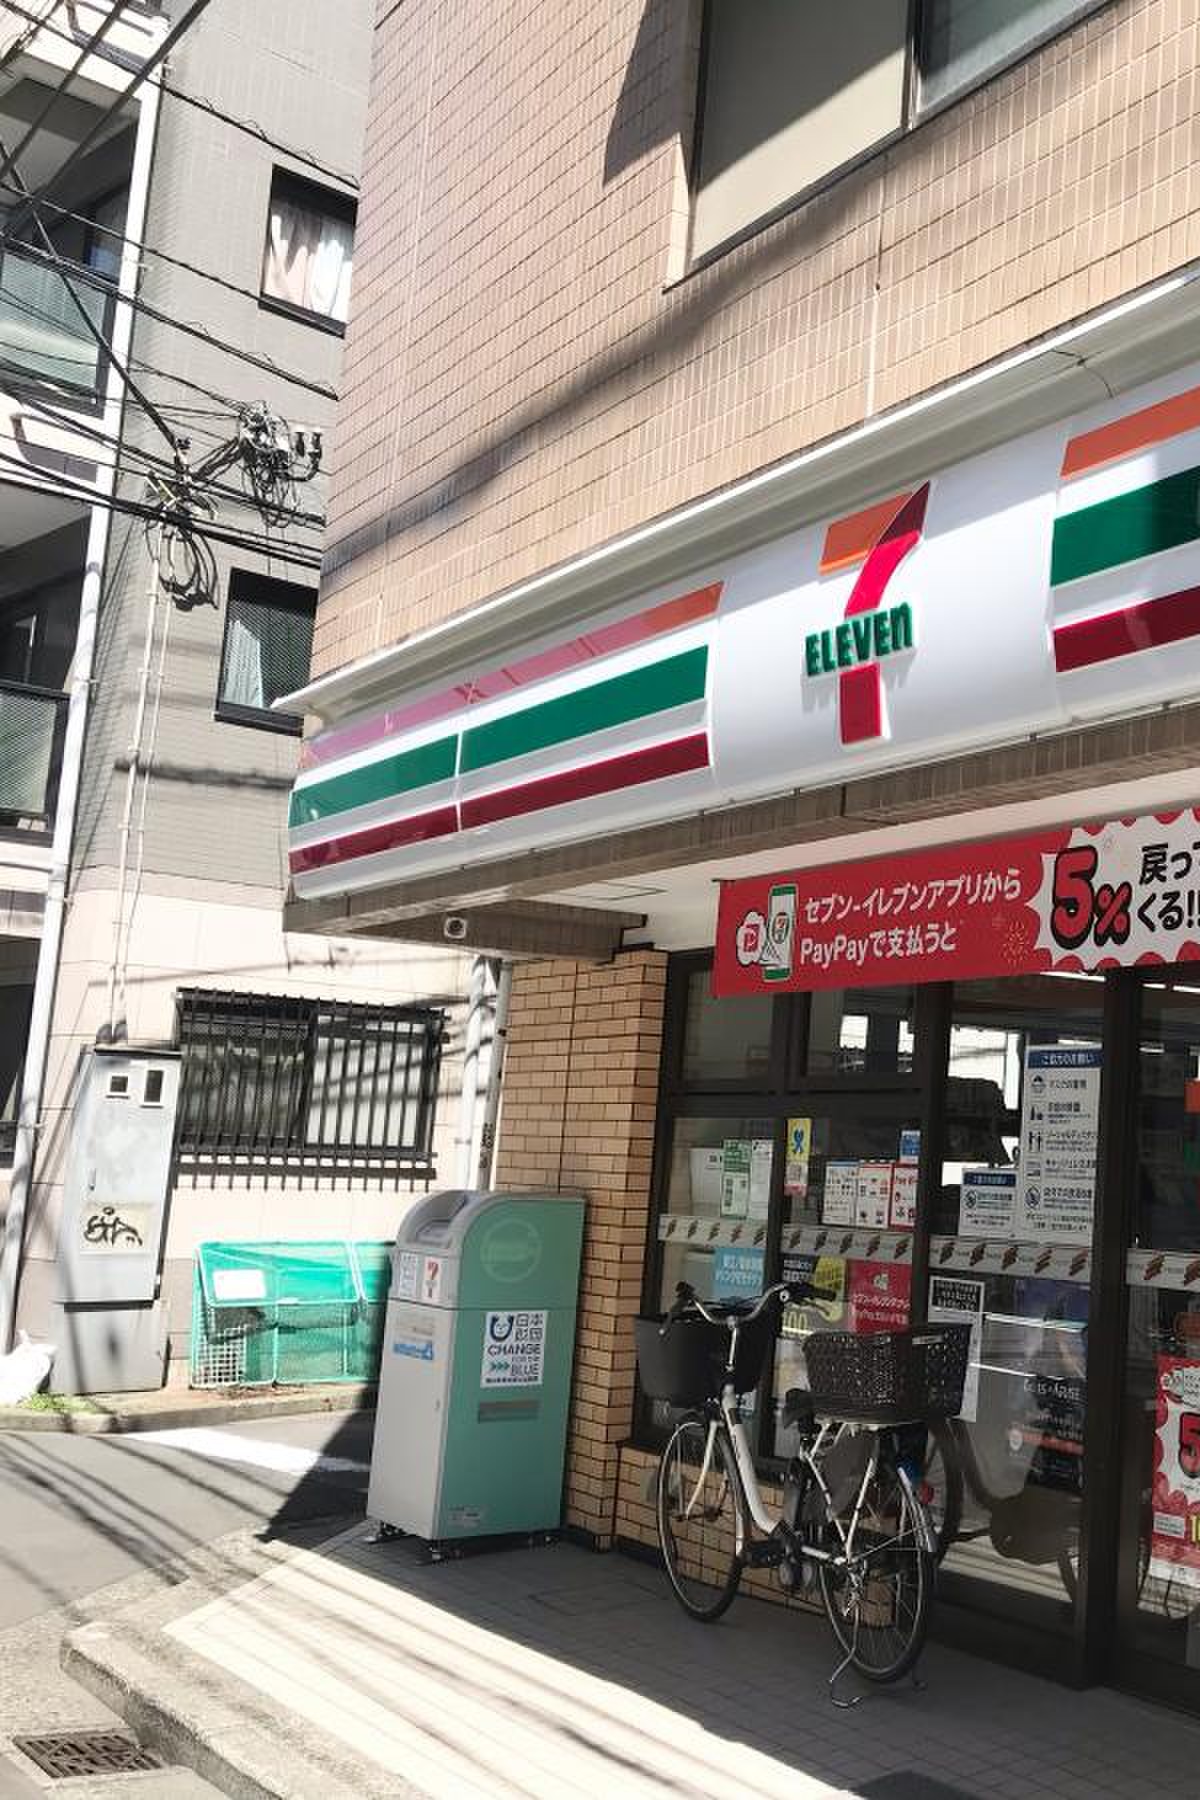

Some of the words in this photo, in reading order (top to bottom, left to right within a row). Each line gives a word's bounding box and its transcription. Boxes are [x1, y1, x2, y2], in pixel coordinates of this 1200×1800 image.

[1051, 845, 1133, 949] 5%
[800, 922, 957, 969] PayPayで支払うと
